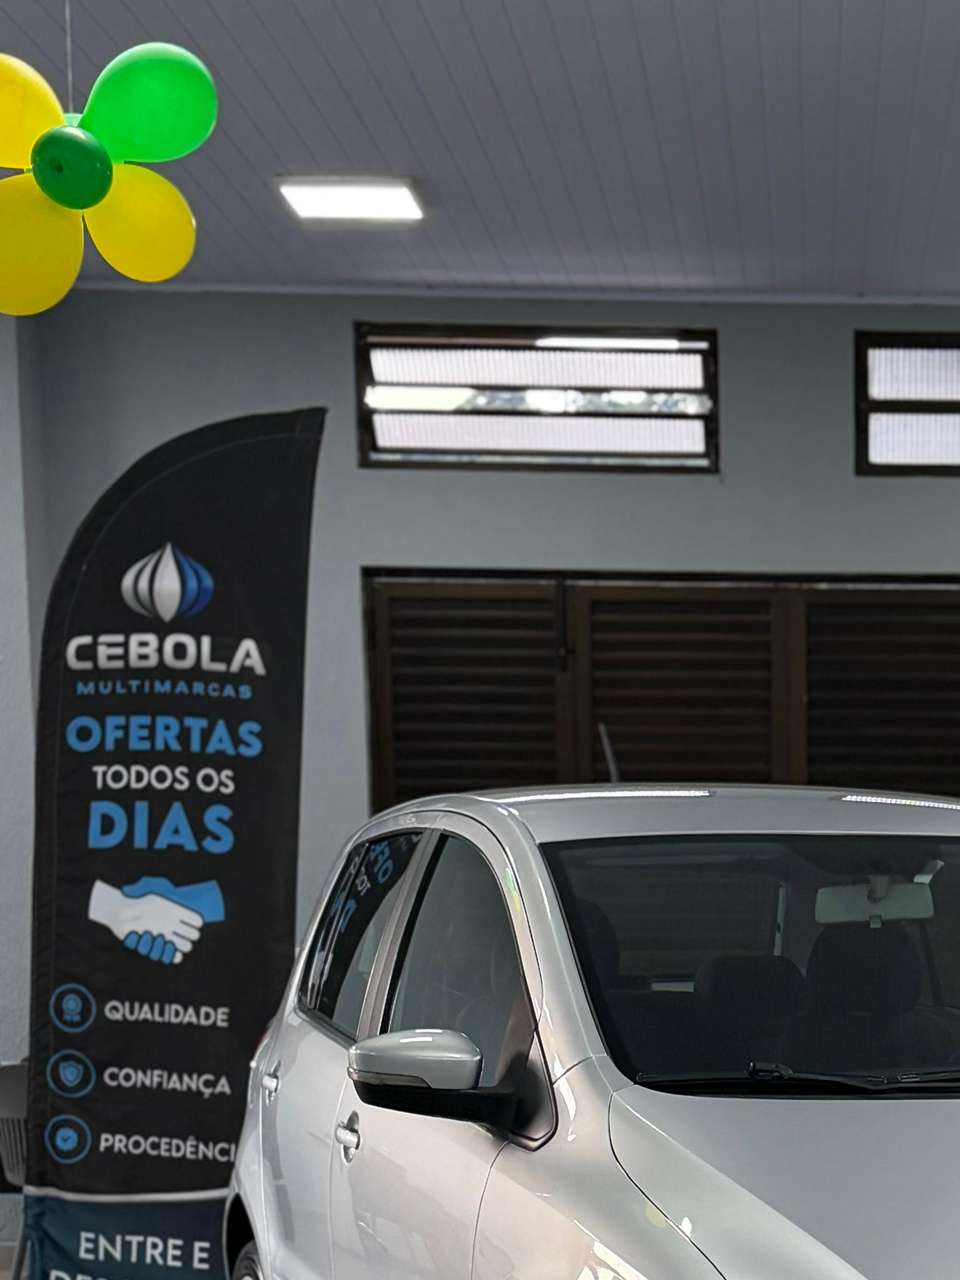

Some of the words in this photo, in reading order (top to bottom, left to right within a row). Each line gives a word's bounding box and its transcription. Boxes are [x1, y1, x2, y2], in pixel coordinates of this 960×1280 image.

[65, 632, 267, 676] CEBOLA
[75, 680, 253, 700] MULTIMARCAS
[65, 715, 263, 758] OFERTAS
[91, 764, 189, 791] TODOS
[196, 767, 236, 795] OS
[87, 801, 236, 855] DIAS
[104, 999, 231, 1028] QUALIDADE
[103, 1067, 232, 1099] CONFIANÇA
[99, 1133, 236, 1162] PROCEDÊNCI
[79, 1231, 183, 1268] ENTRE
[193, 1241, 211, 1270] E
